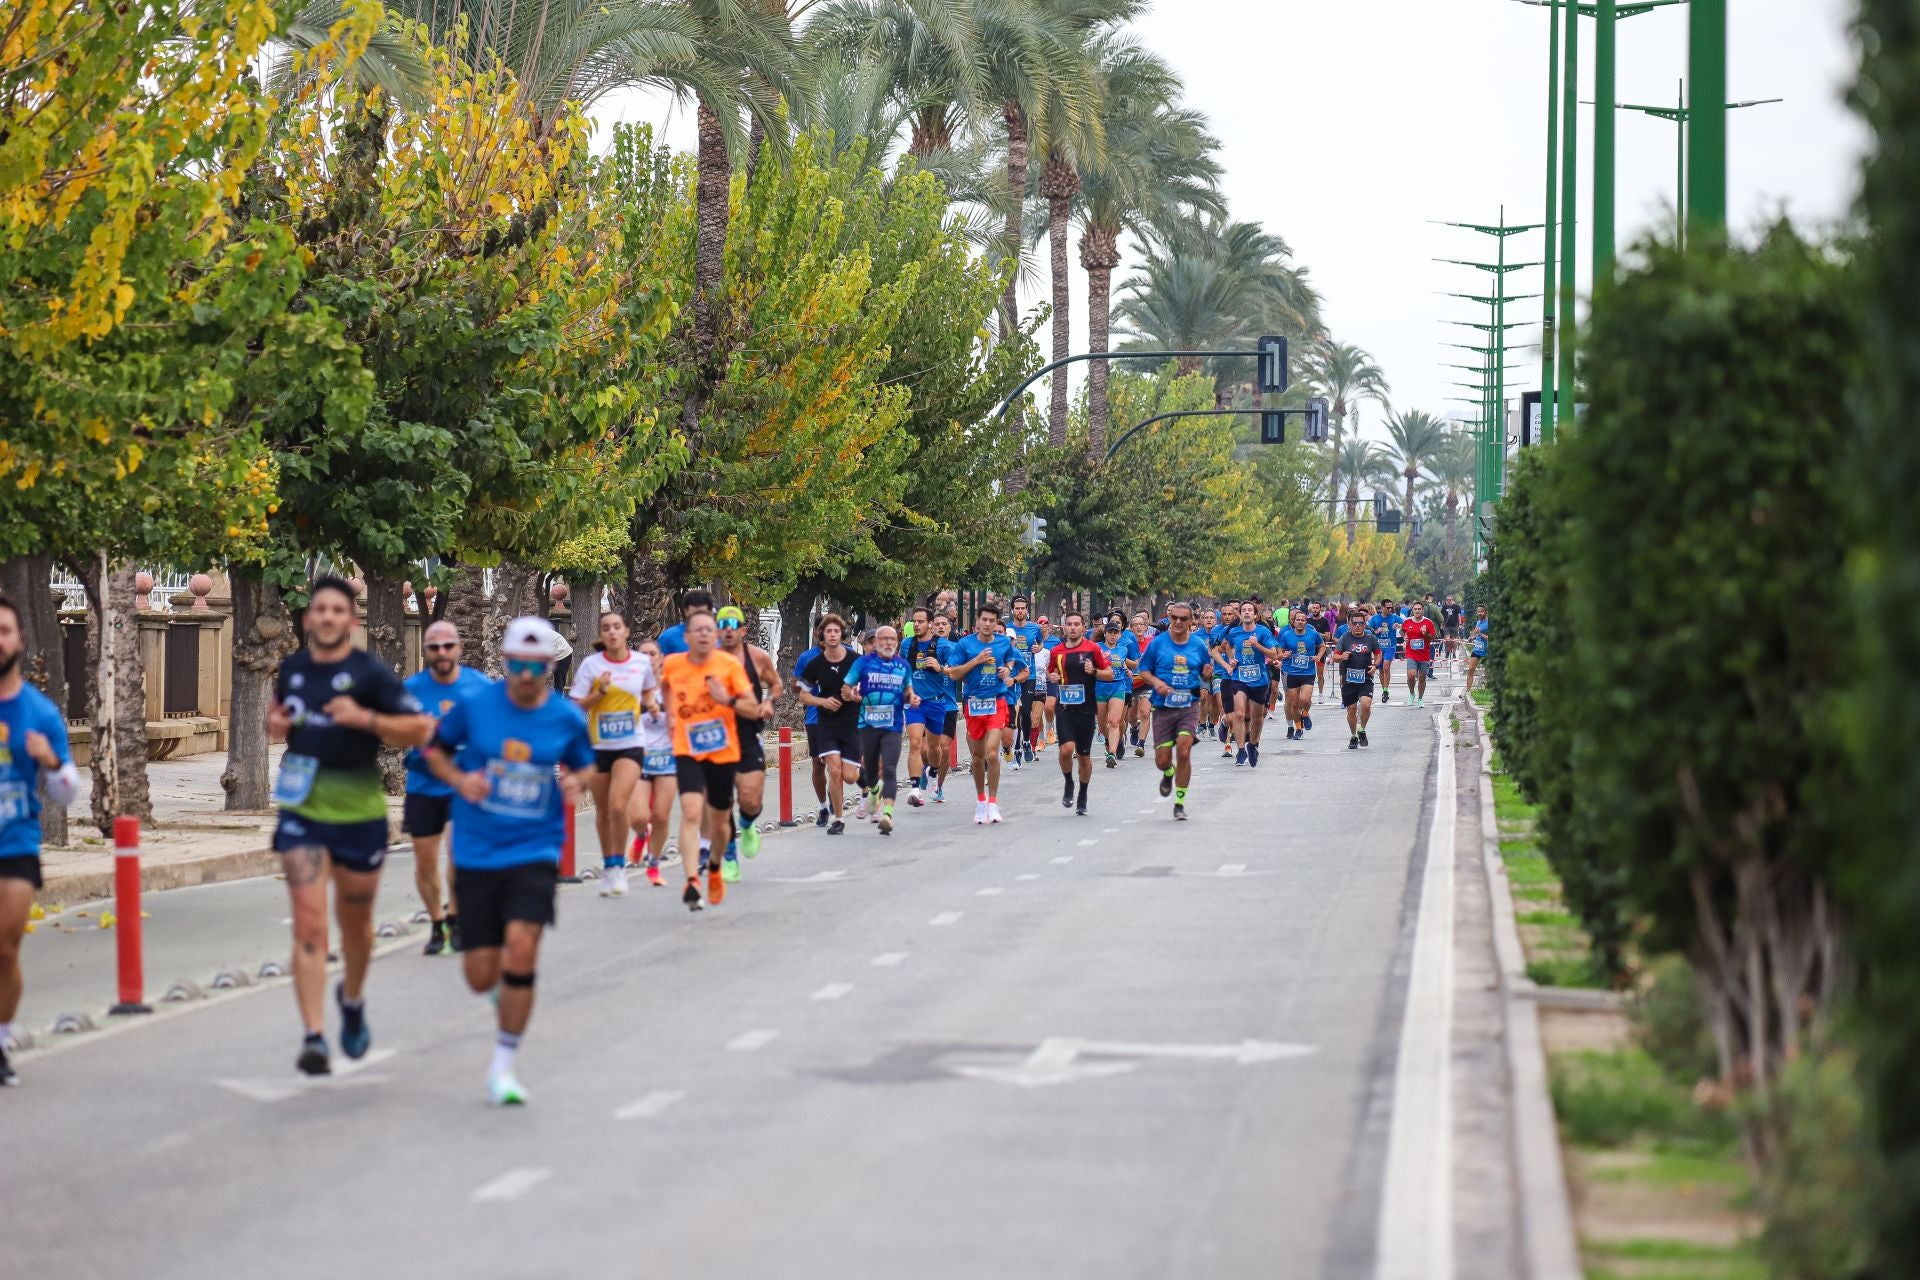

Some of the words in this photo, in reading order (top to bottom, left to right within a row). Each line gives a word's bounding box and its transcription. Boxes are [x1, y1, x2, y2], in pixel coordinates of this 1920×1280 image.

[1064, 691, 1080, 699] 179
[971, 702, 994, 710] 1222
[867, 712, 891, 720] 4003
[695, 728, 722, 744] 433
